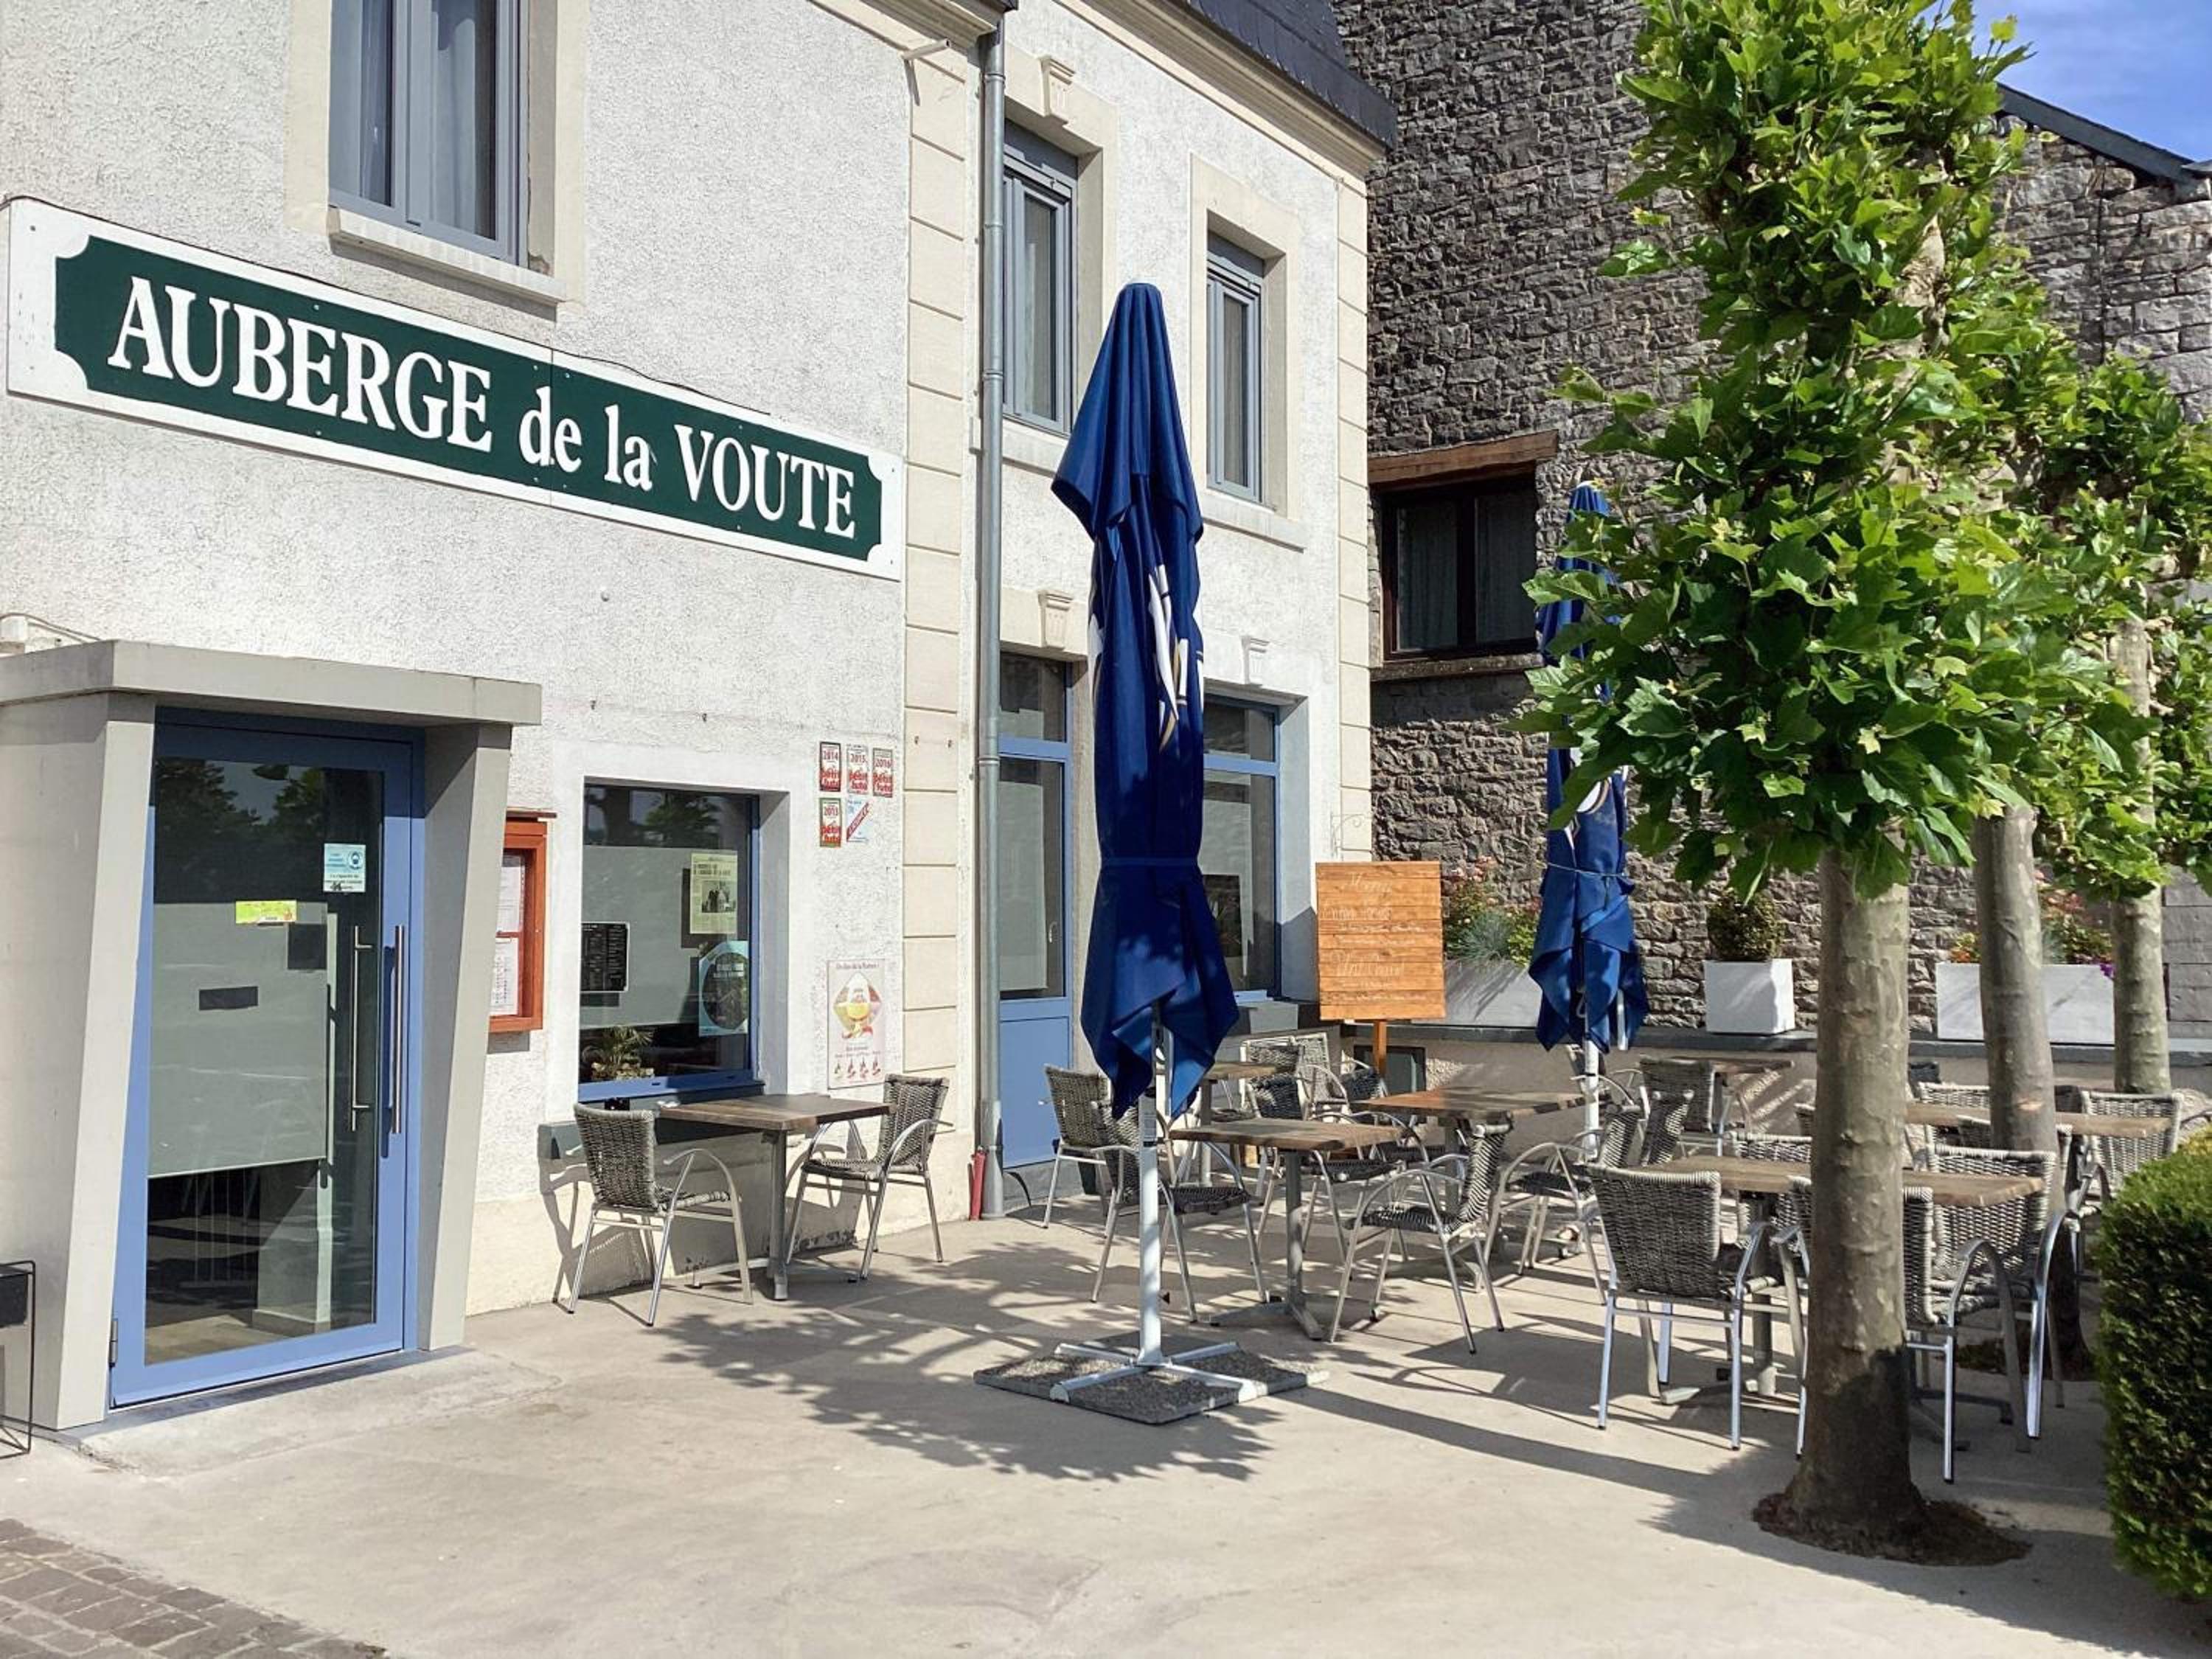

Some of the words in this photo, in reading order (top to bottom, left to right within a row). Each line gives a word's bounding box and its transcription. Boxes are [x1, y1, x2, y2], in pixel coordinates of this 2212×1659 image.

[107, 276, 493, 452] AUBERGE
[519, 386, 582, 473] de
[604, 405, 652, 491] la
[674, 424, 855, 539] VOUTE
